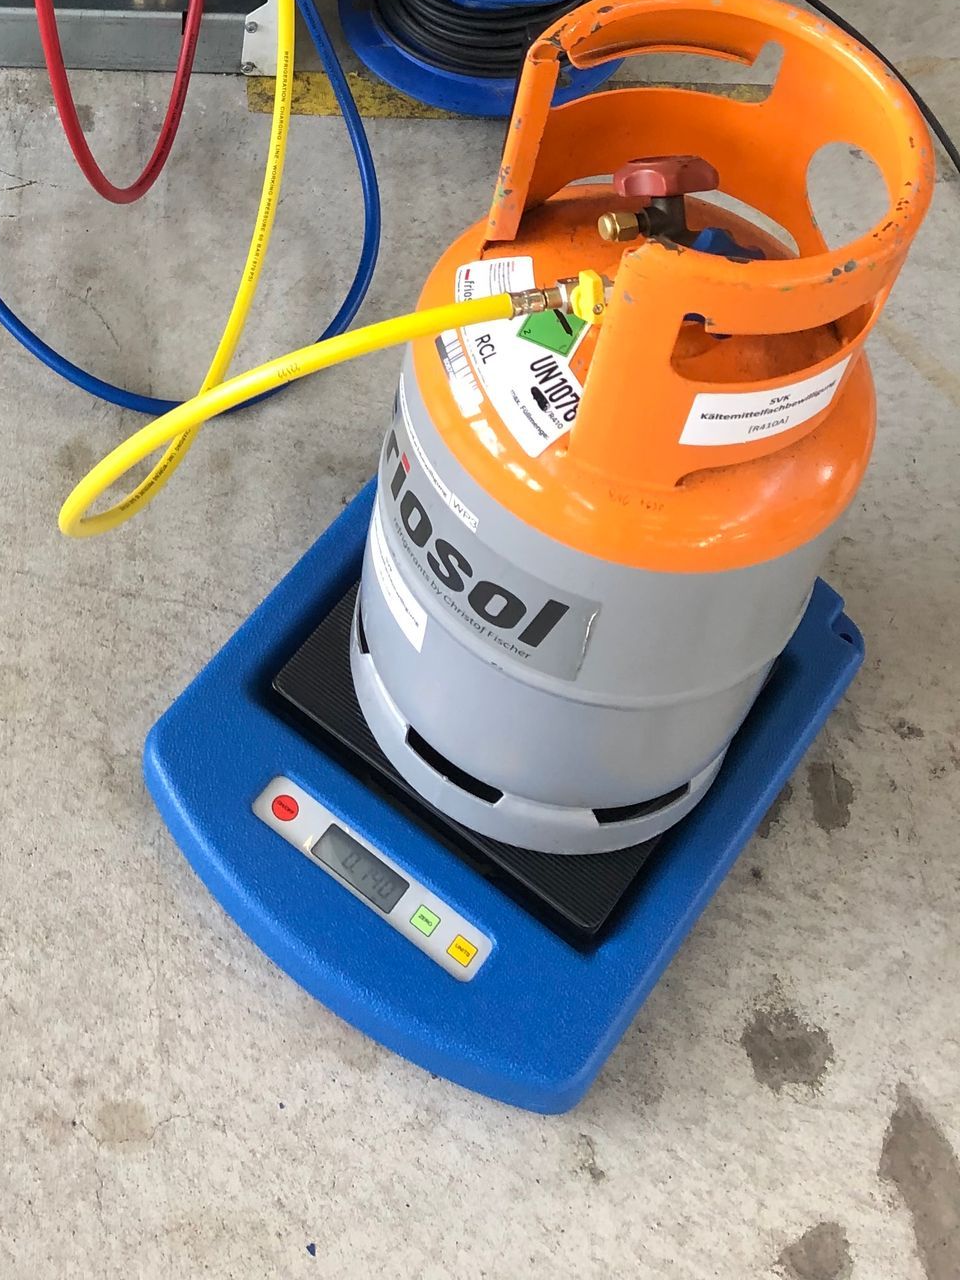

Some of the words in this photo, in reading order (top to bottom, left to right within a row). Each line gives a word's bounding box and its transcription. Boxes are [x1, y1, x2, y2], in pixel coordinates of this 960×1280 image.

[281, 51, 289, 102] REFRIGERATION
[276, 106, 285, 141] CHARGING
[266, 163, 278, 196] WORKING
[260, 197, 272, 232] PRESSURE
[475, 333, 497, 364] RCL
[510, 389, 521, 407] max.
[700, 379, 836, 420] Kältemittelfachbewilligung
[769, 394, 791, 406] SVK
[748, 416, 790, 434] [R410A]
[386, 390, 570, 648] riosol
[451, 501, 478, 529] WP3
[392, 517, 430, 583] refrigerants
[431, 580, 442, 597] by
[443, 593, 485, 634] Christof
[488, 631, 532, 660] Fischer
[418, 913, 433, 927] ZERO
[454, 942, 471, 958] UNITS
